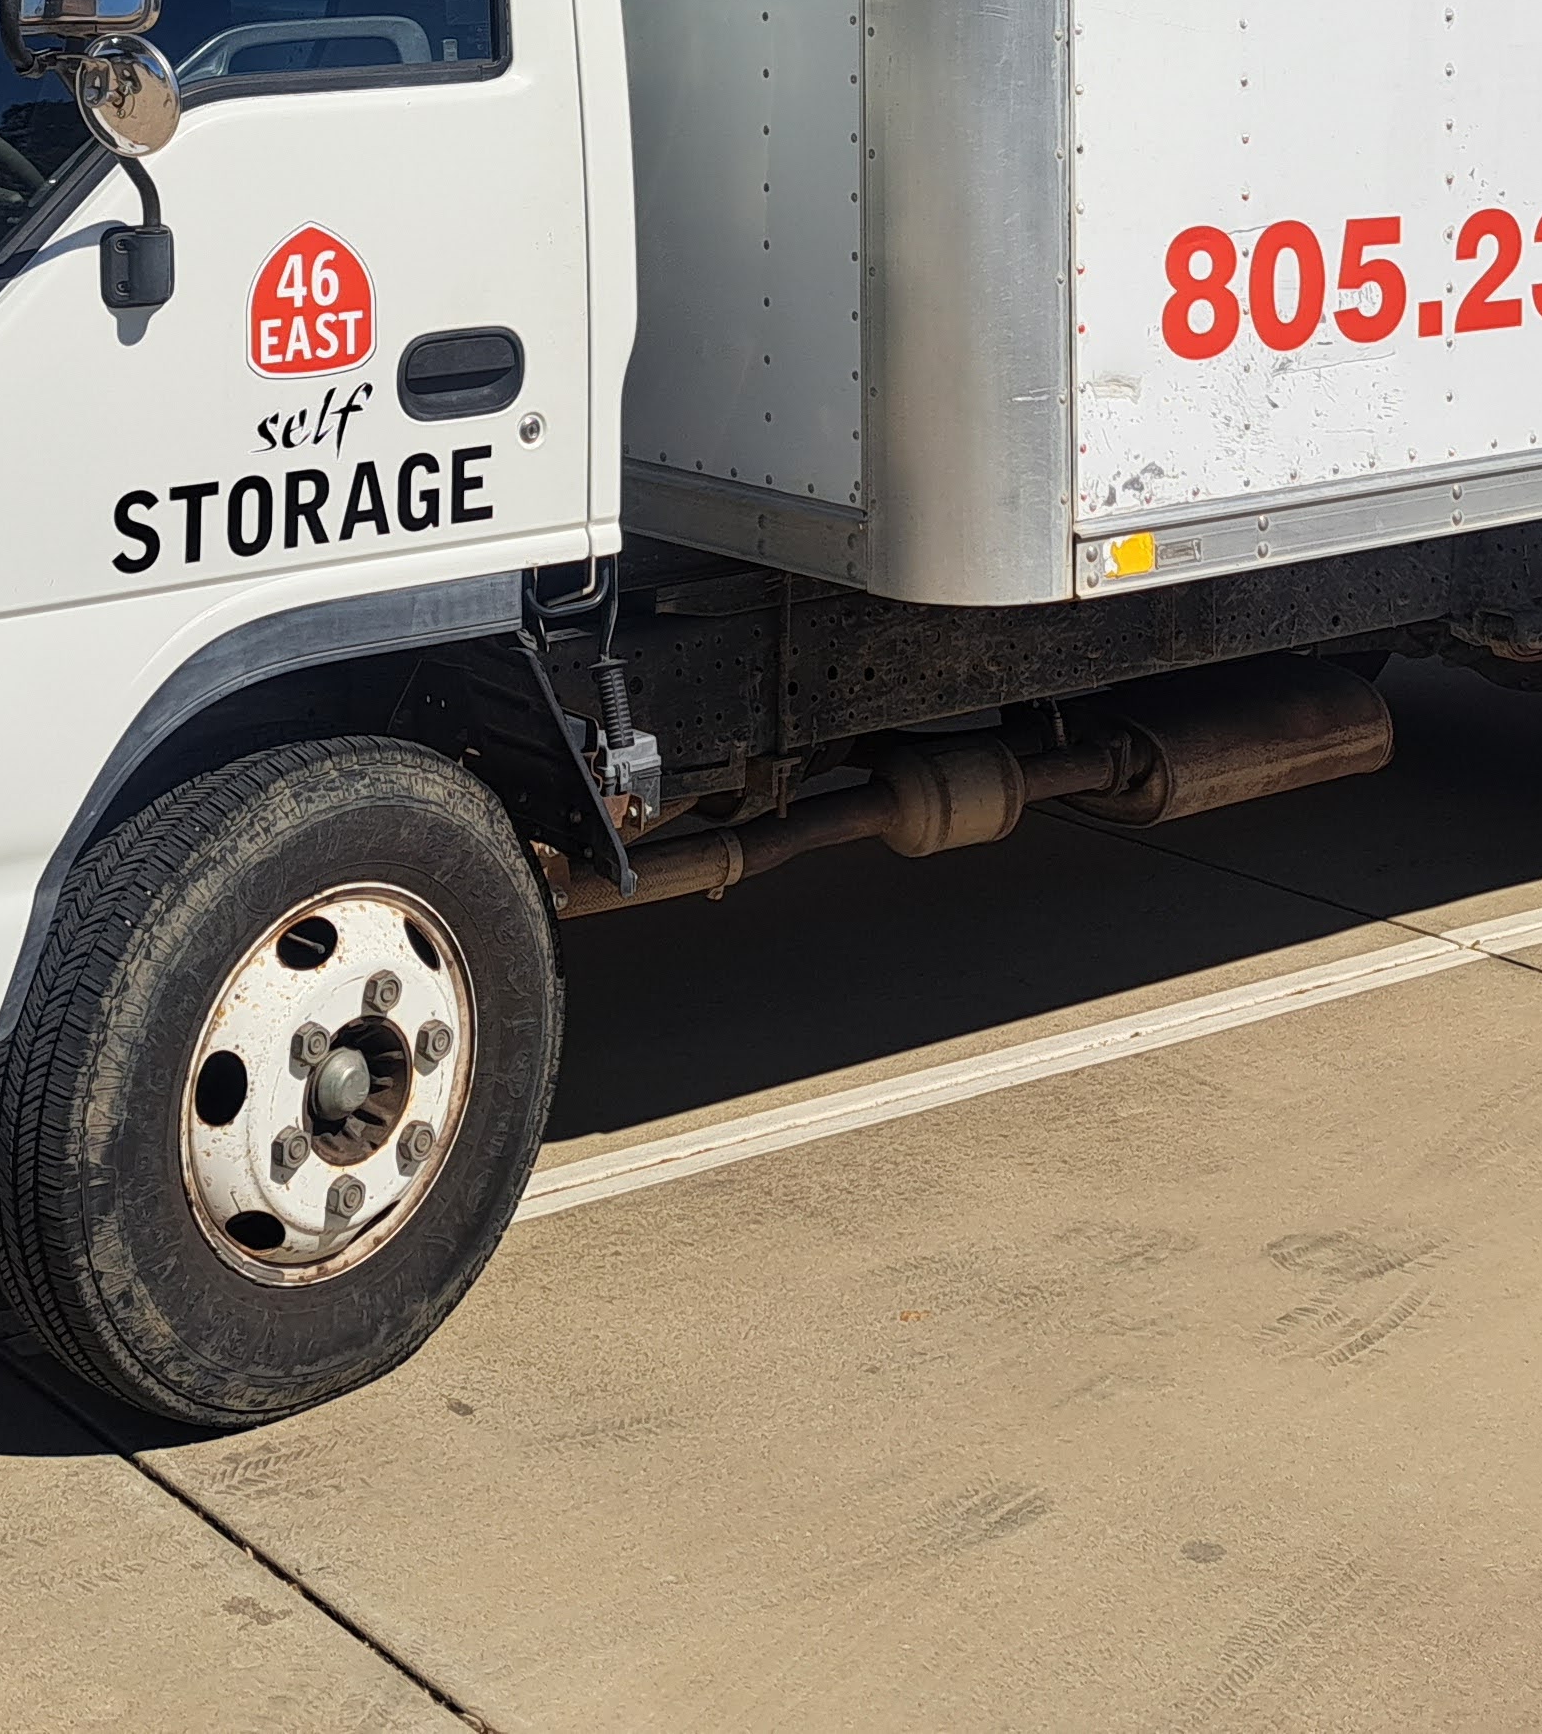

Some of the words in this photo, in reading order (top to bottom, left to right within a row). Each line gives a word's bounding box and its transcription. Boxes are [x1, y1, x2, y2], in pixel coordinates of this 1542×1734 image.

[276, 250, 340, 308] 46
[260, 310, 364, 365] EAST
[254, 382, 373, 458] self
[111, 444, 493, 574] STORAGE
